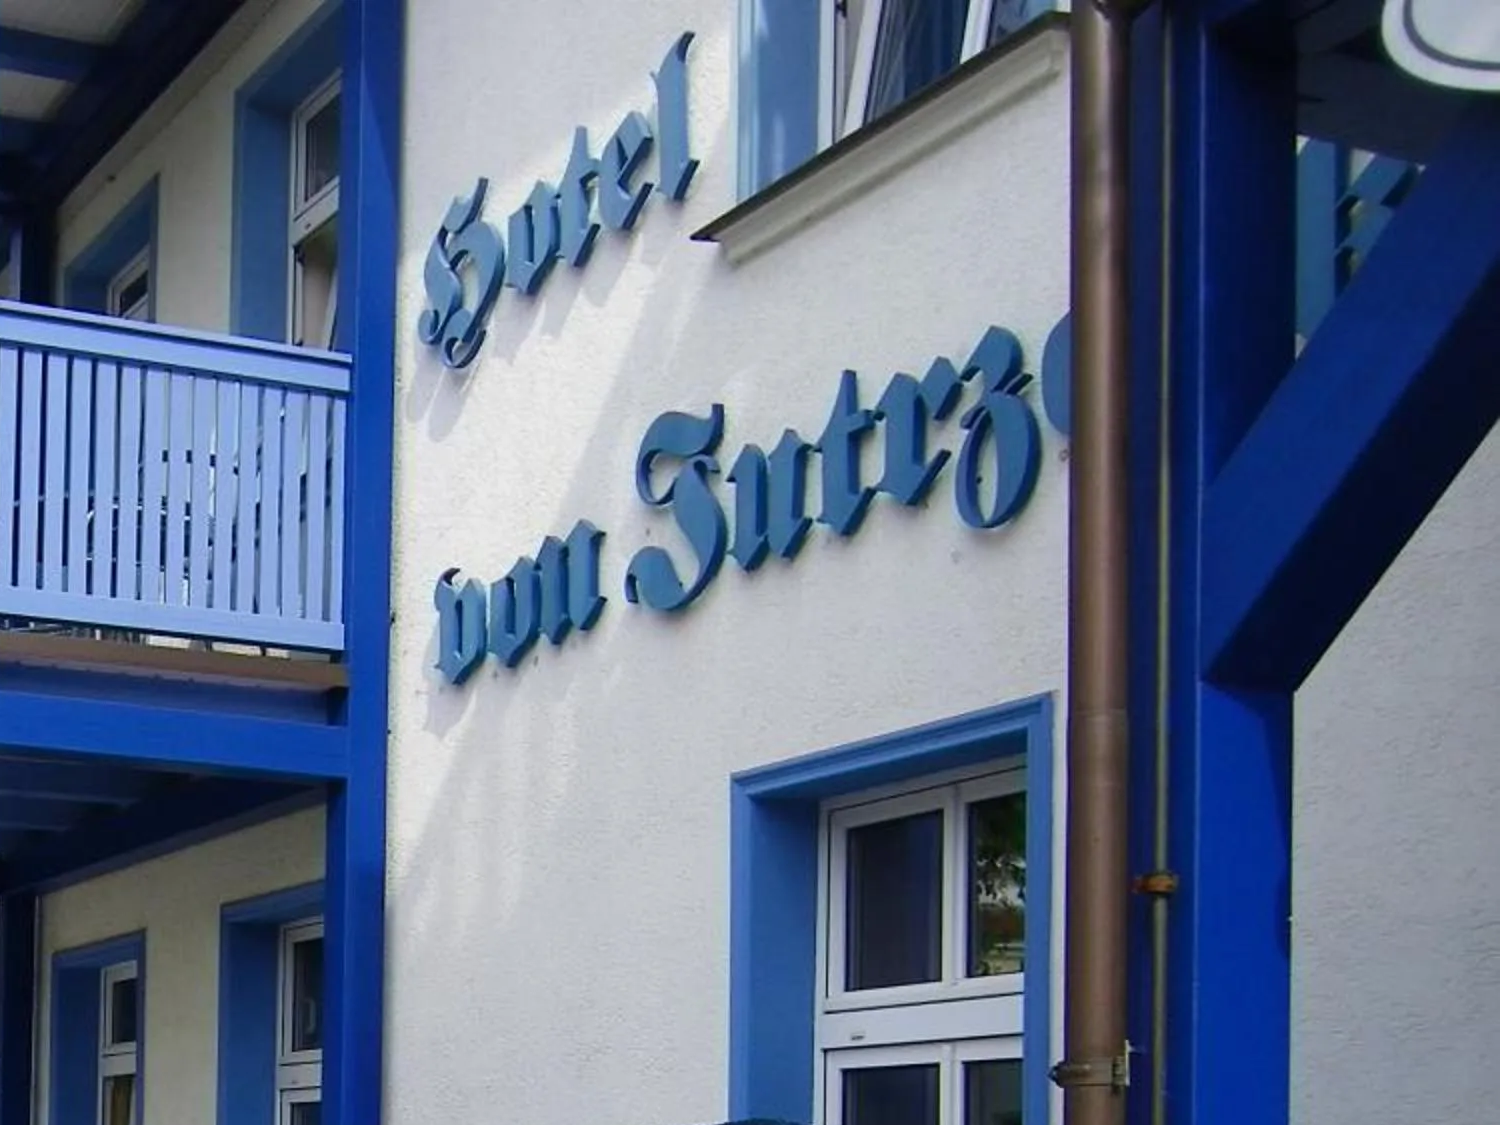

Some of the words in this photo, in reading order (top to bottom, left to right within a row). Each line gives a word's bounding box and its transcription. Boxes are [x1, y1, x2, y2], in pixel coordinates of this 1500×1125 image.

[417, 31, 699, 369] Hotel
[434, 518, 607, 685] von
[625, 305, 1071, 613] Jutrz
